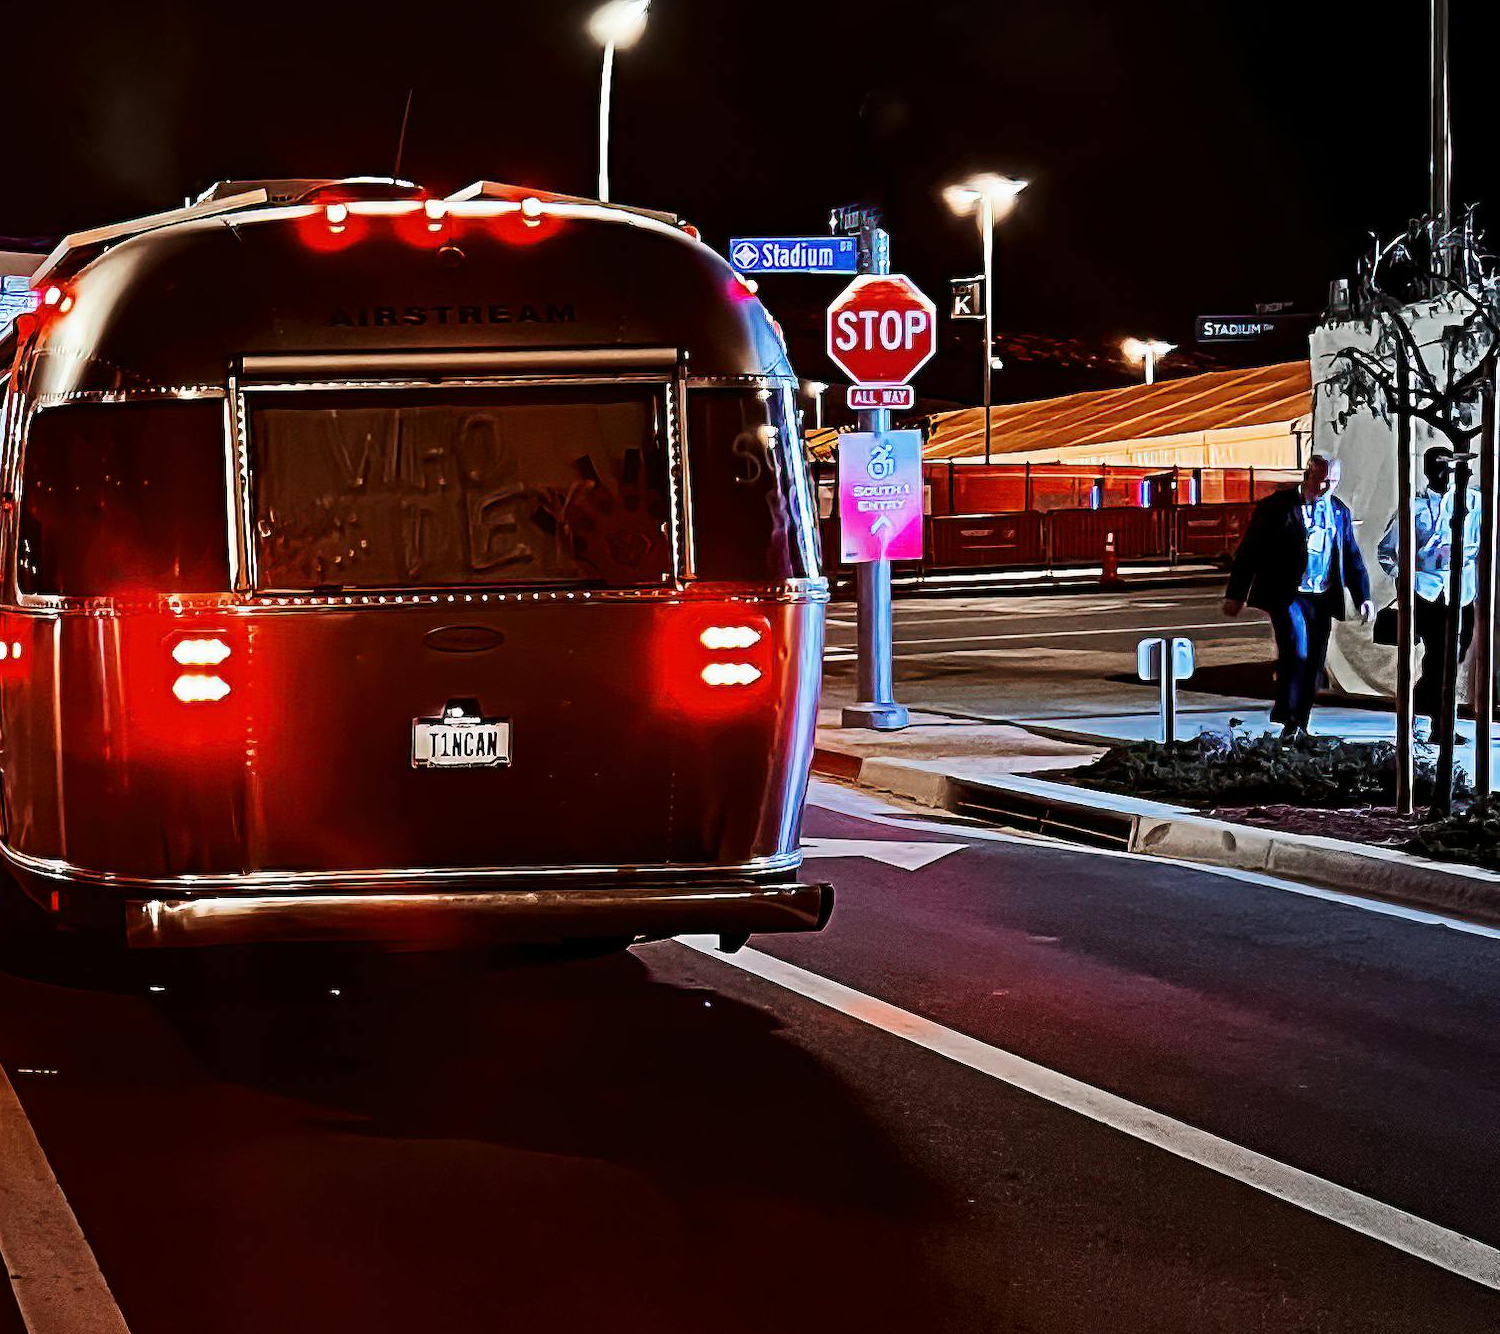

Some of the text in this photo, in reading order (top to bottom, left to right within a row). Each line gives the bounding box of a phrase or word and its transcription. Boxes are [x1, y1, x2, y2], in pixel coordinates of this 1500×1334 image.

[761, 242, 834, 268] Stadium
[329, 302, 577, 328] AIRSTREAM
[954, 295, 972, 315] K
[835, 309, 927, 351] STOP
[854, 390, 907, 404] ALL WAY
[852, 485, 902, 498] SOUTH
[857, 499, 907, 512] ENTRY
